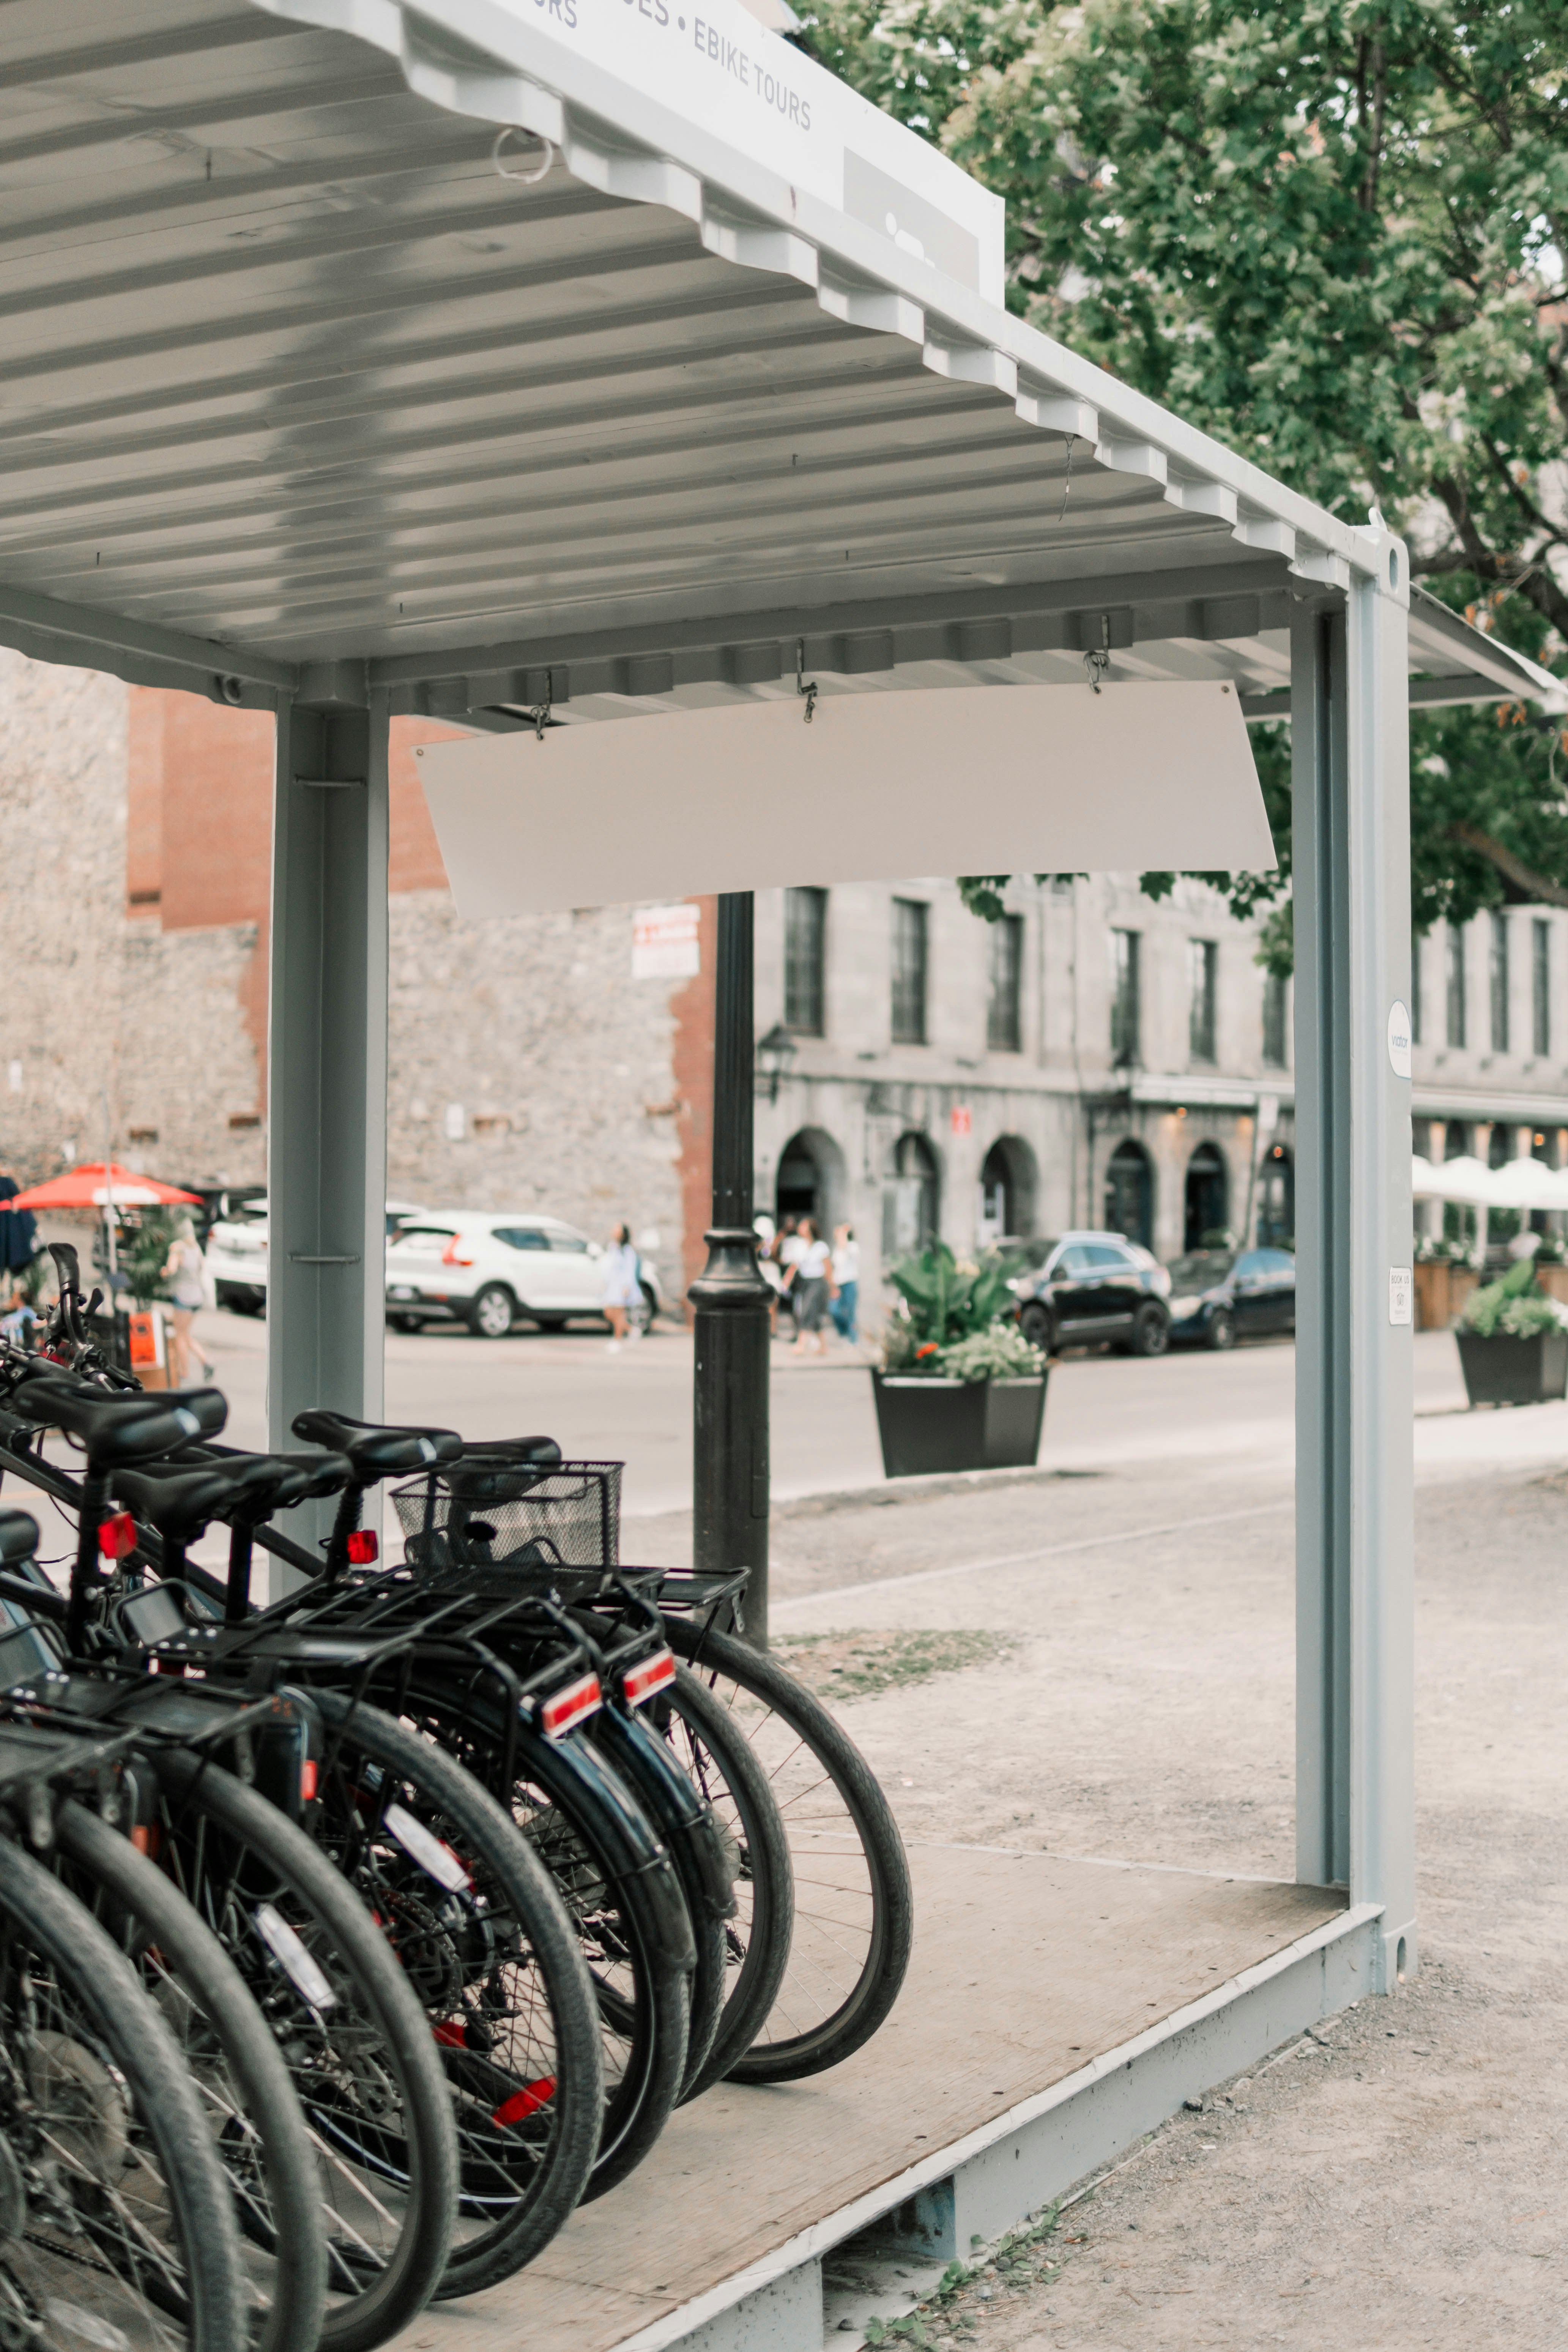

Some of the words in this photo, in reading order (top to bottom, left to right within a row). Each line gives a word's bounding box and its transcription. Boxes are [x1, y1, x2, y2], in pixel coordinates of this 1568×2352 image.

[623, 0, 669, 26] ES
[694, 16, 749, 87] EBIKE
[754, 63, 811, 131] TOURS
[1392, 1034, 1408, 1048] viator
[1391, 1275, 1403, 1284] BOOK
[1404, 1275, 1409, 1284] US
